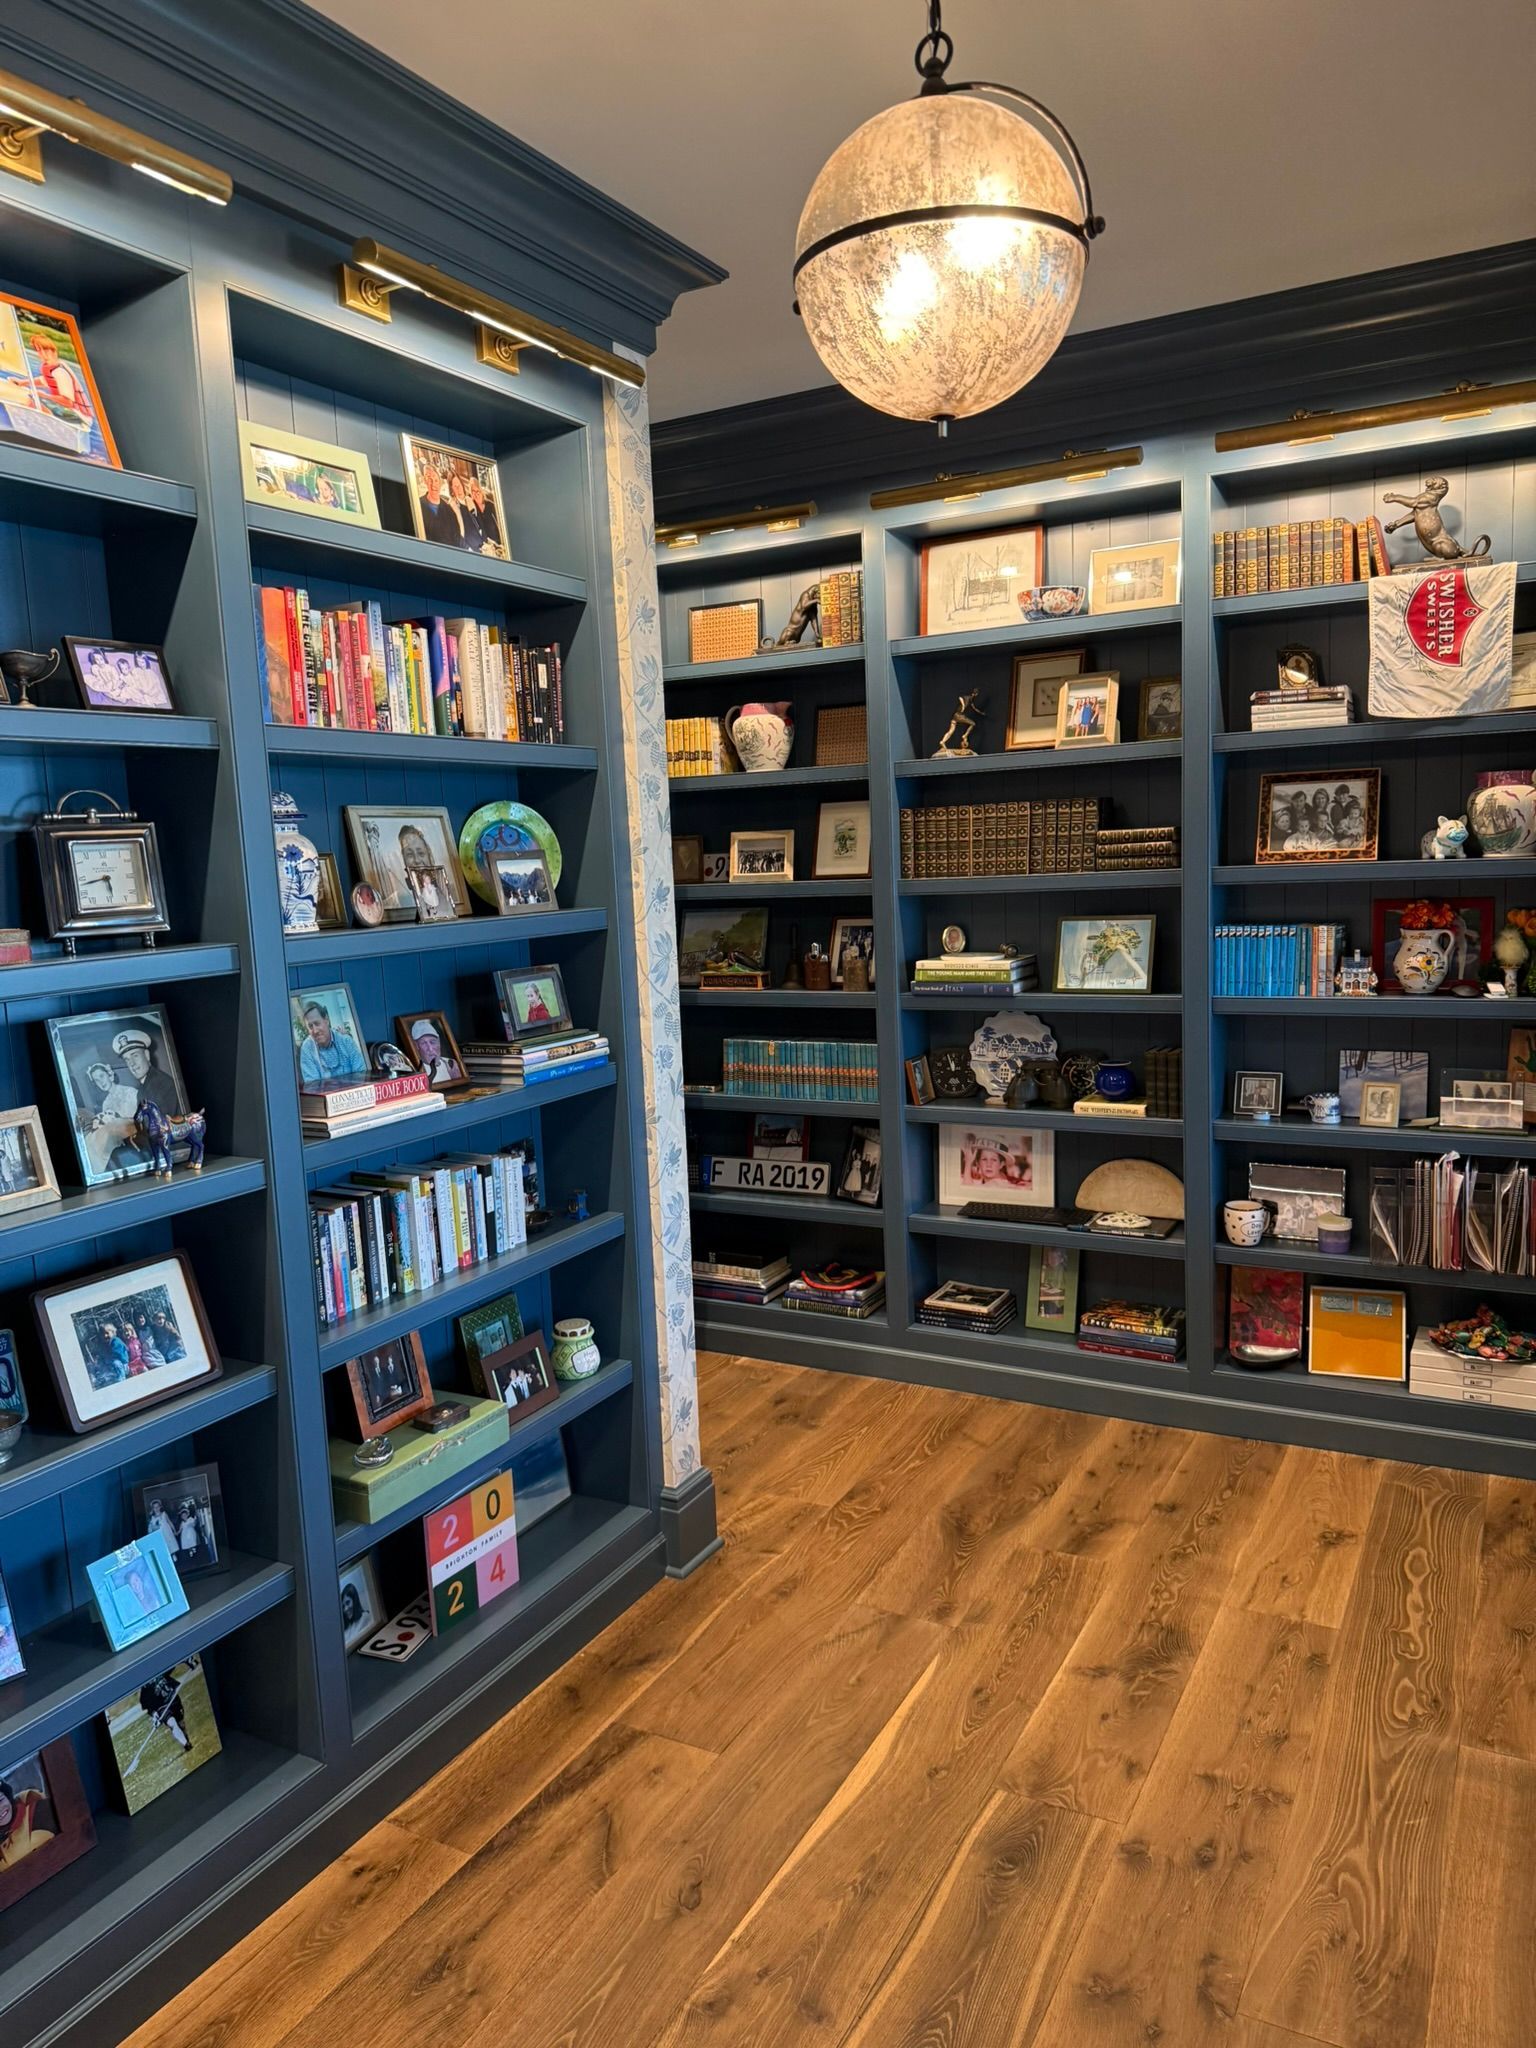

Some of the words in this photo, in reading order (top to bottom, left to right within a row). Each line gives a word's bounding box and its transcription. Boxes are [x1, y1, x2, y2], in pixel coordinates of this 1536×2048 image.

[302, 608, 310, 629] THE
[1426, 581, 1437, 651] SWEETS
[1438, 571, 1456, 658] SWISHER
[304, 633, 315, 679] COMING
[309, 683, 319, 714] WAVE
[945, 984, 965, 993] ITALY
[331, 1085, 374, 1104] CONNECTICUT
[375, 1081, 402, 1101] HOME
[403, 1075, 426, 1095] BOOK
[711, 1160, 725, 1182] F
[738, 1162, 765, 1187] RA
[769, 1164, 825, 1190] 2019
[441, 1514, 459, 1550] 2
[486, 1489, 500, 1521] 0
[445, 1545, 478, 1570] BRIGHTON
[481, 1529, 503, 1548] FAMILY
[447, 1580, 465, 1617] 2
[489, 1553, 506, 1583] 4
